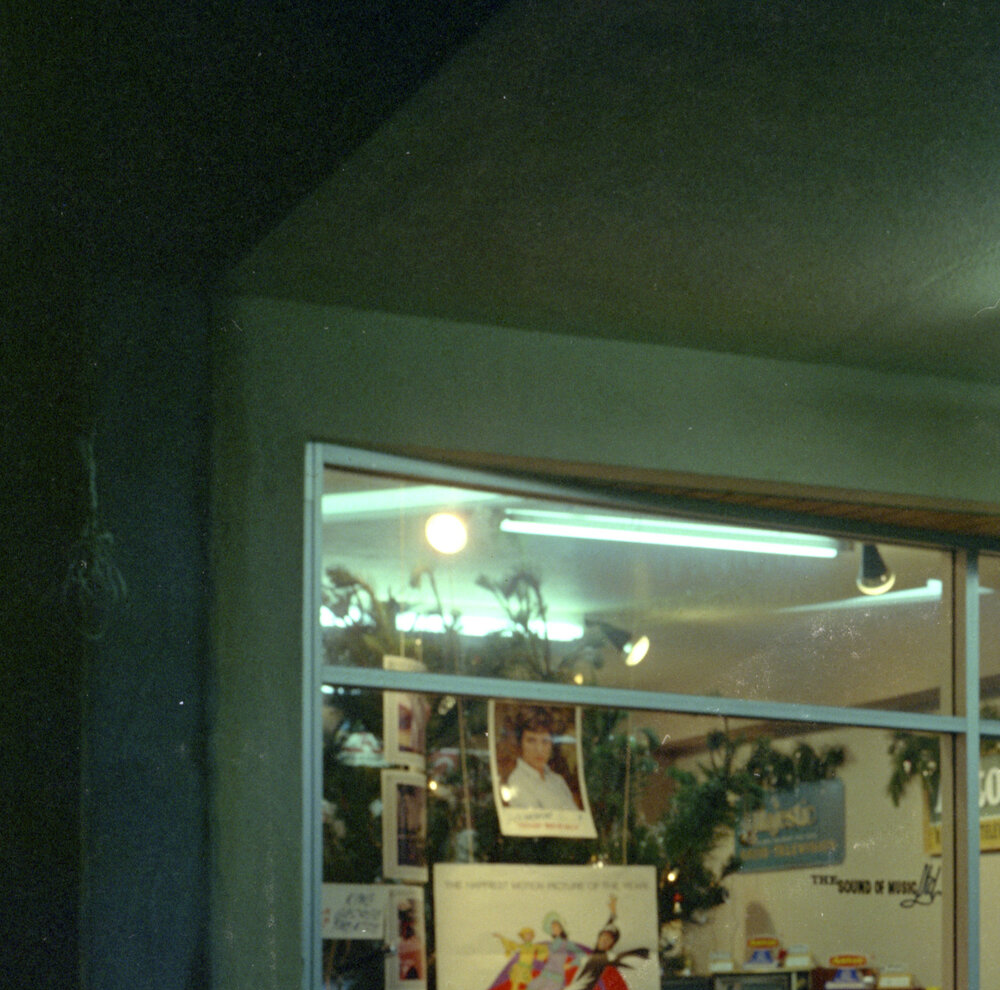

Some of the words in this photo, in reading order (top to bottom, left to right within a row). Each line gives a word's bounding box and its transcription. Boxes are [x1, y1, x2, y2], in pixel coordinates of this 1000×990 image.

[812, 875, 838, 886] THE
[838, 879, 871, 895] SOUND
[875, 879, 886, 895] OF
[888, 880, 918, 895] MUSIC
